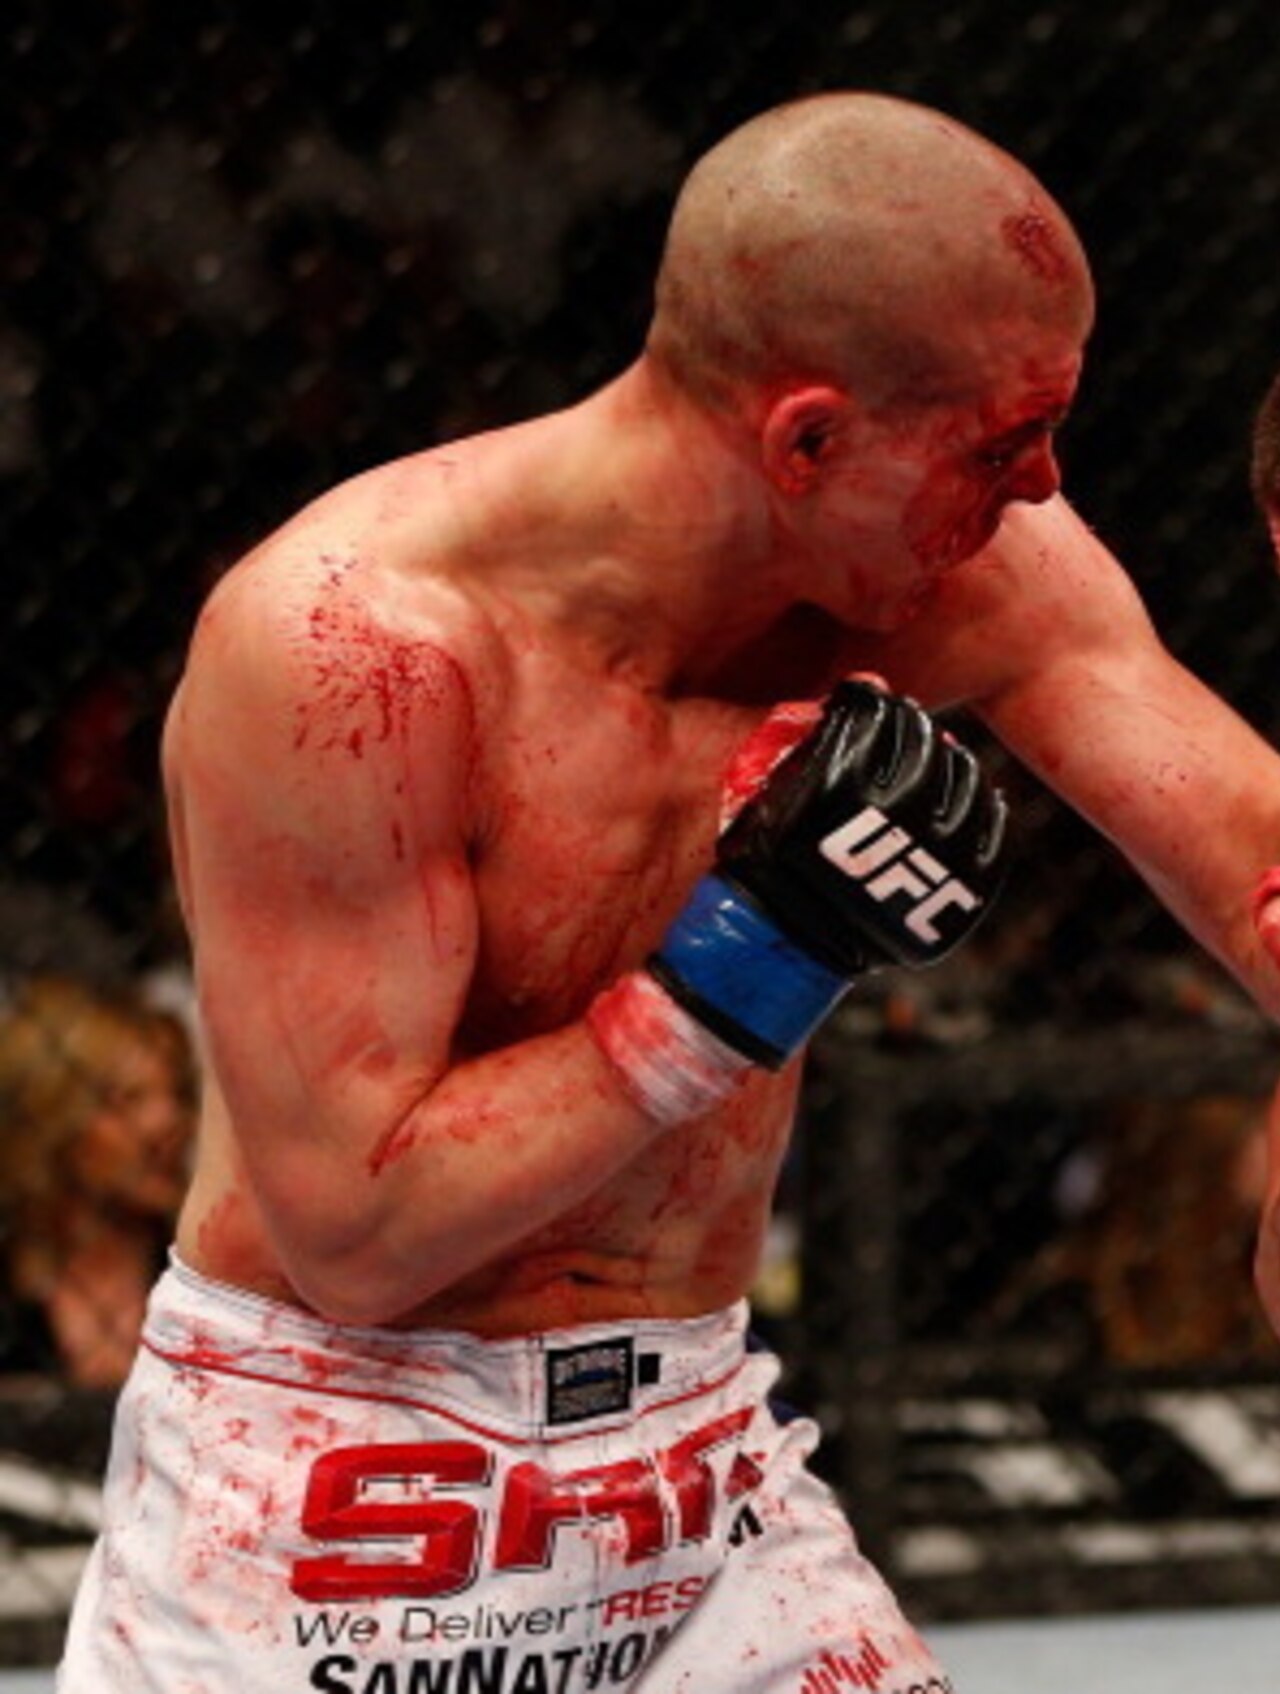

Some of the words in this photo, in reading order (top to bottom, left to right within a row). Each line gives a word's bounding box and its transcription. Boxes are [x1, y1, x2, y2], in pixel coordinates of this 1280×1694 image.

[818, 805, 983, 945] UFC
[292, 1608, 380, 1647] We
[400, 1603, 577, 1645] Deliver
